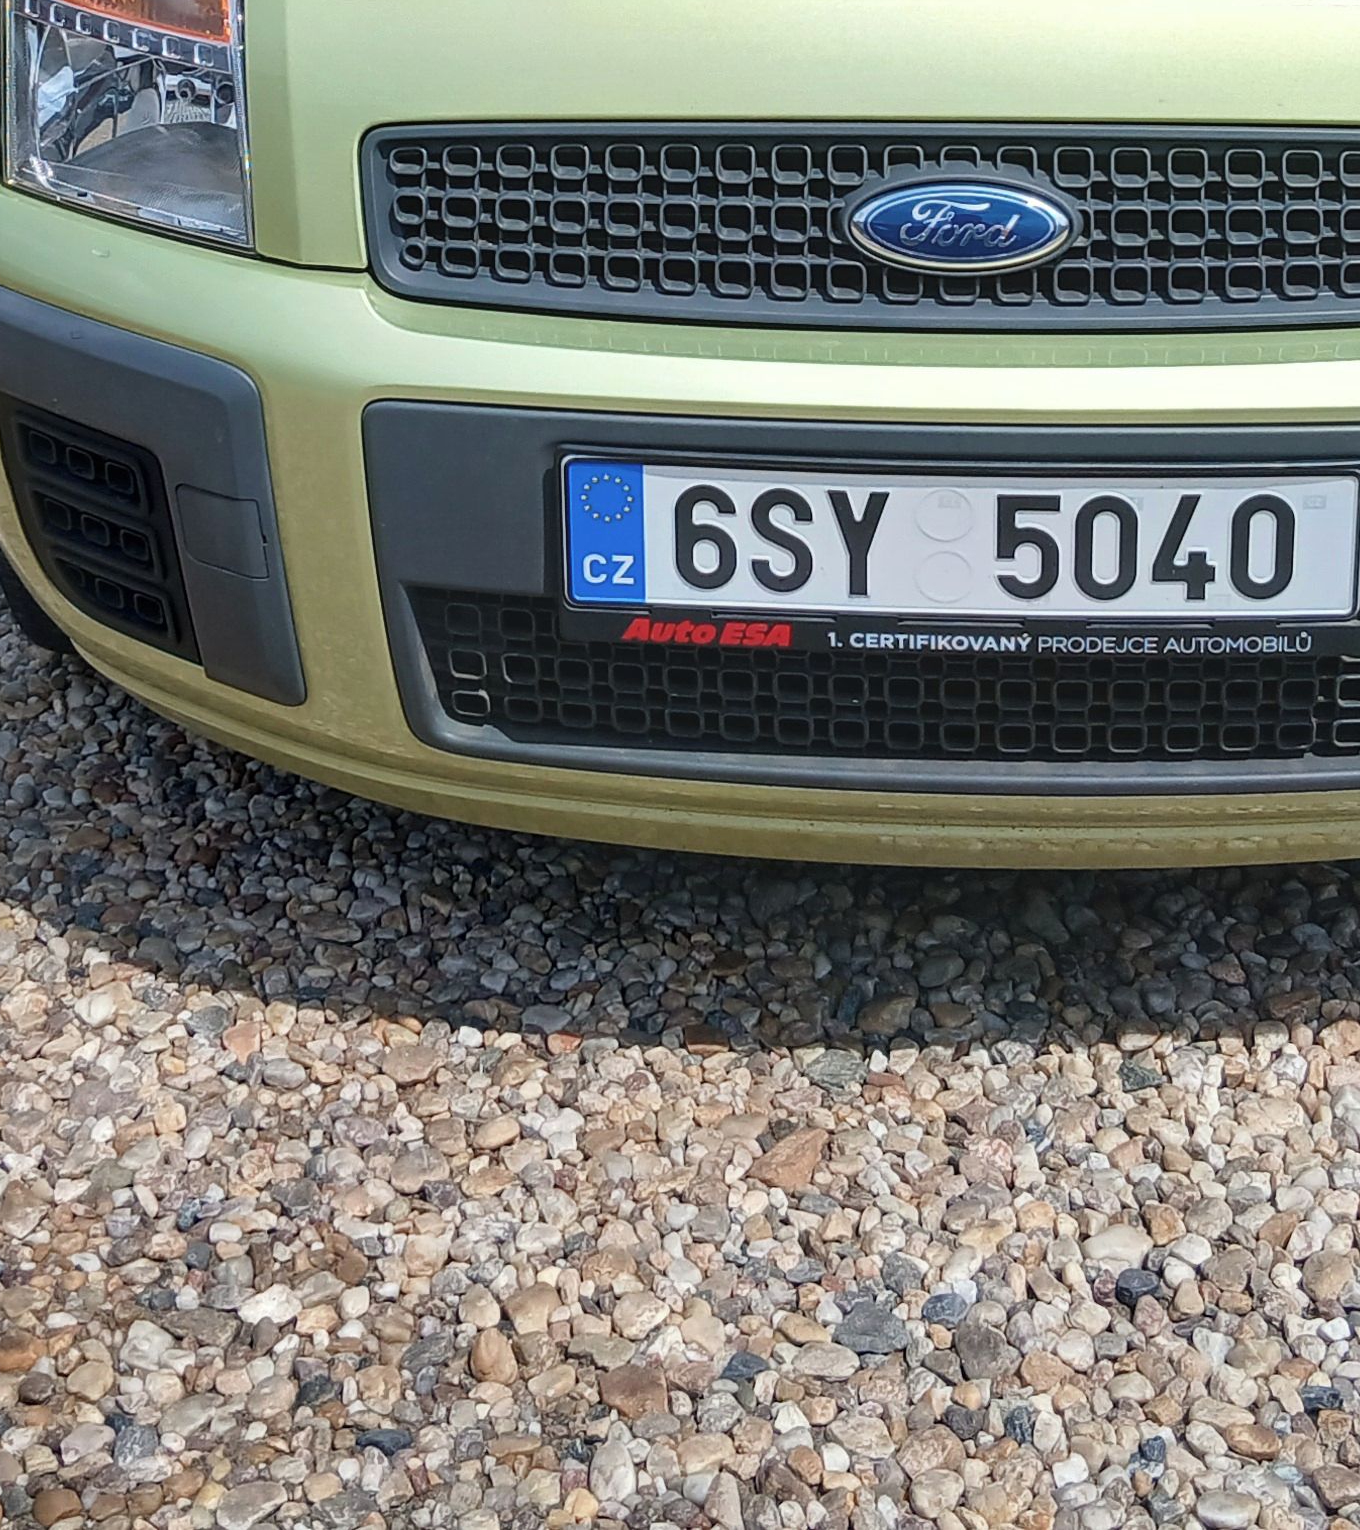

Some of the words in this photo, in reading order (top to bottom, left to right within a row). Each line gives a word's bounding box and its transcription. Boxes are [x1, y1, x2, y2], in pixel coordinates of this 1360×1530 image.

[898, 199, 1021, 248] Ford
[674, 483, 890, 596] 6SY
[996, 493, 1296, 601] 5040
[582, 553, 635, 585] CZ
[621, 617, 717, 644] Auto
[718, 621, 793, 647] ESA
[827, 632, 843, 648] 1.
[849, 632, 1032, 652] CERTIFIKOVANÝ
[1038, 636, 1159, 654] PRODEJCE
[1163, 631, 1312, 654] AUTOMOBILŮ
